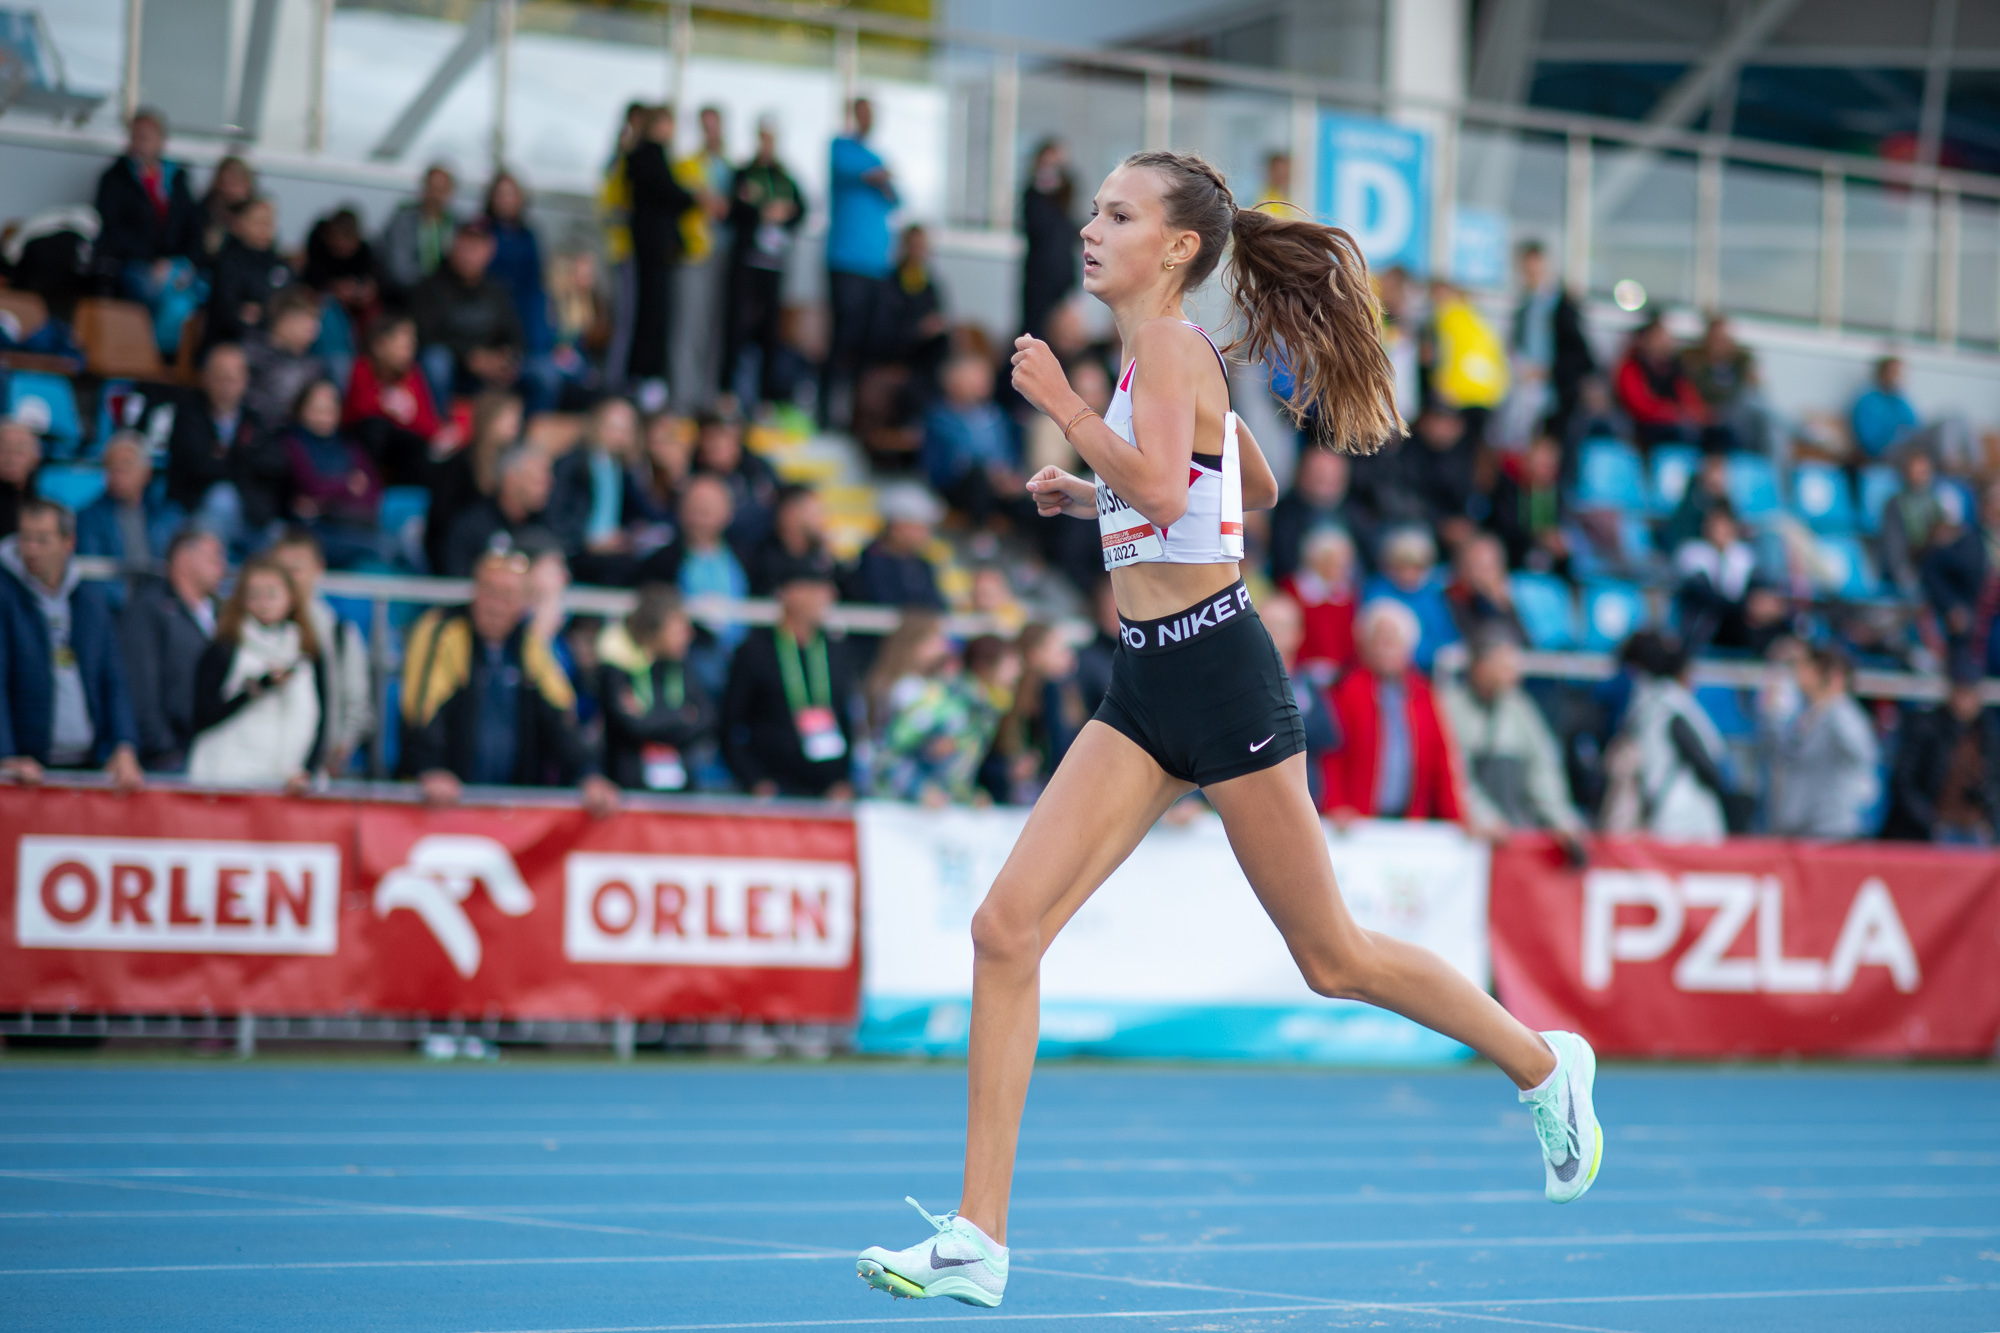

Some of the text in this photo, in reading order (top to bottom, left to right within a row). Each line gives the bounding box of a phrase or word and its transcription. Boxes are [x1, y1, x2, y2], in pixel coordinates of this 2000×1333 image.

[1337, 160, 1413, 260] D
[1113, 543, 1139, 562] 2022
[1158, 594, 1237, 647] NIKE
[40, 860, 313, 927] ORLEN
[590, 879, 828, 941] ORLEN
[1580, 868, 1923, 994] PZLA
